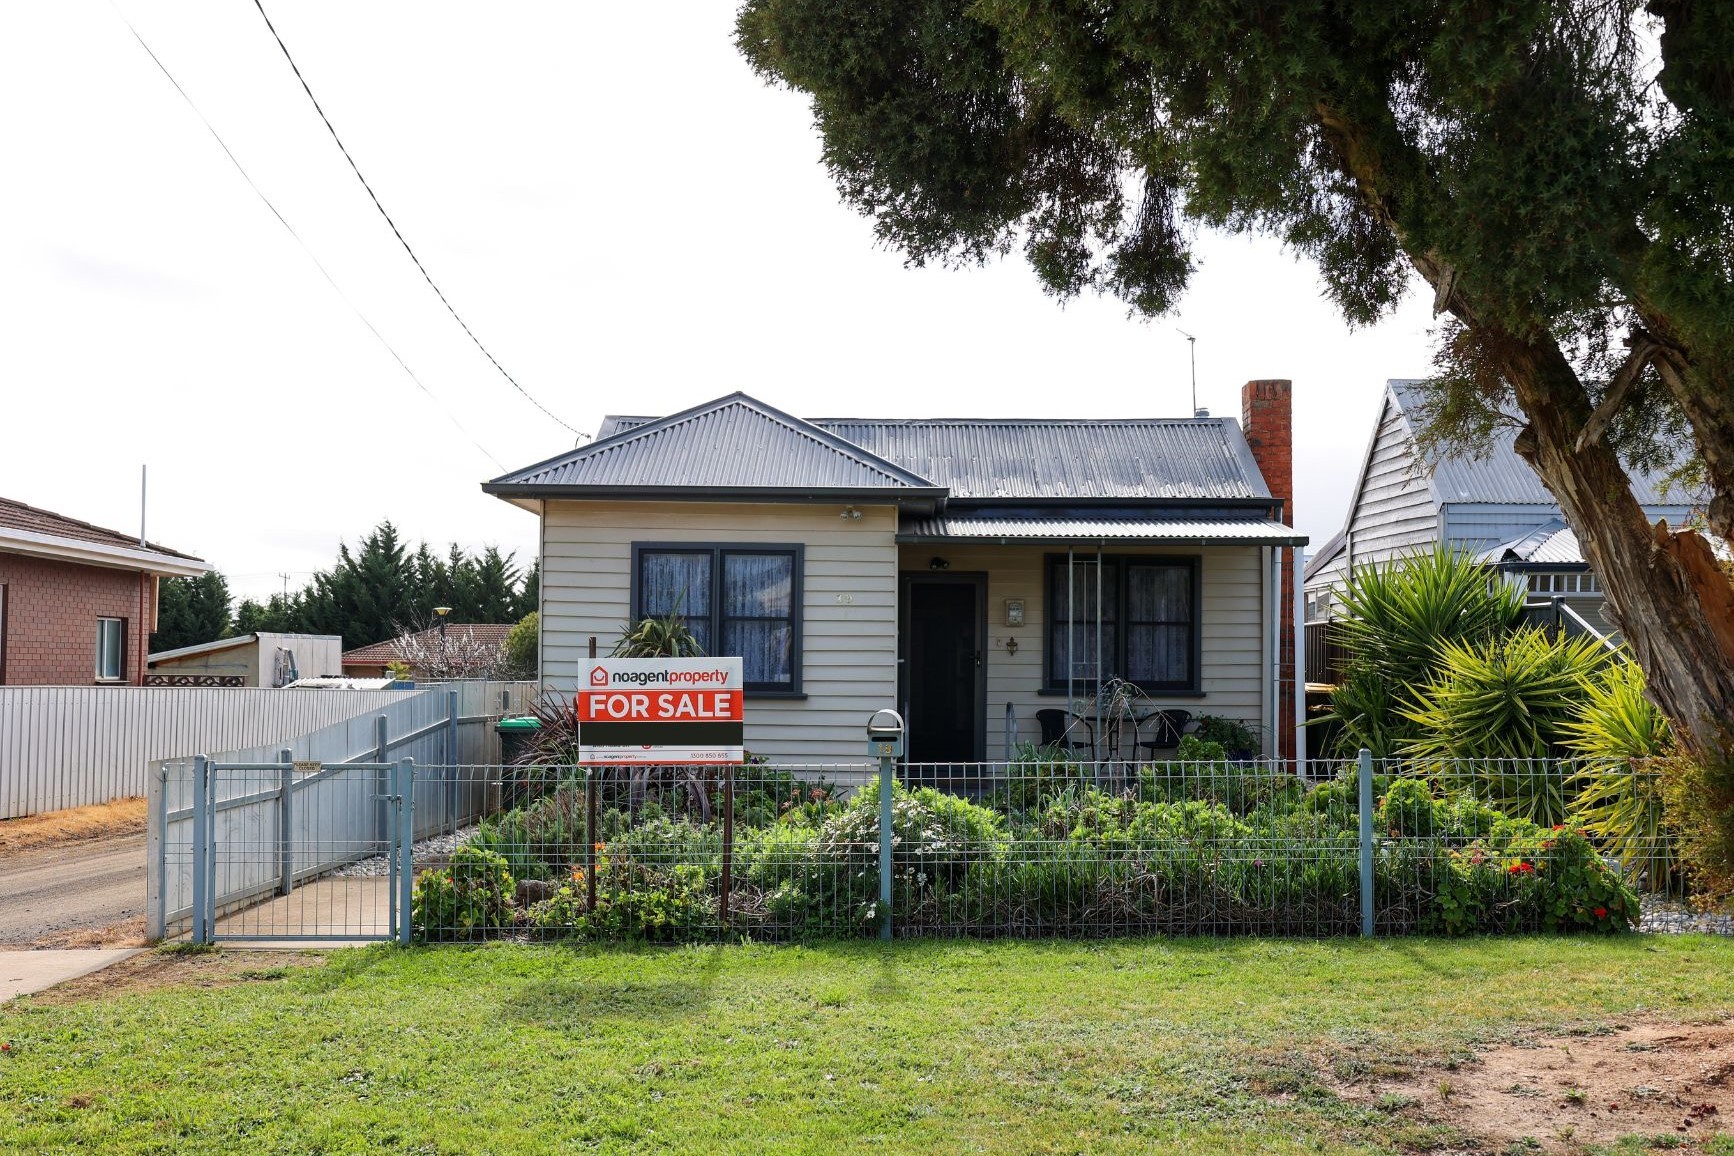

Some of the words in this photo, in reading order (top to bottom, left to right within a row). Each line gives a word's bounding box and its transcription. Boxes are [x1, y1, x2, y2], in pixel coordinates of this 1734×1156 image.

[612, 669, 729, 686] noagentproperty
[589, 694, 650, 719] FOR
[657, 693, 731, 718] SALE
